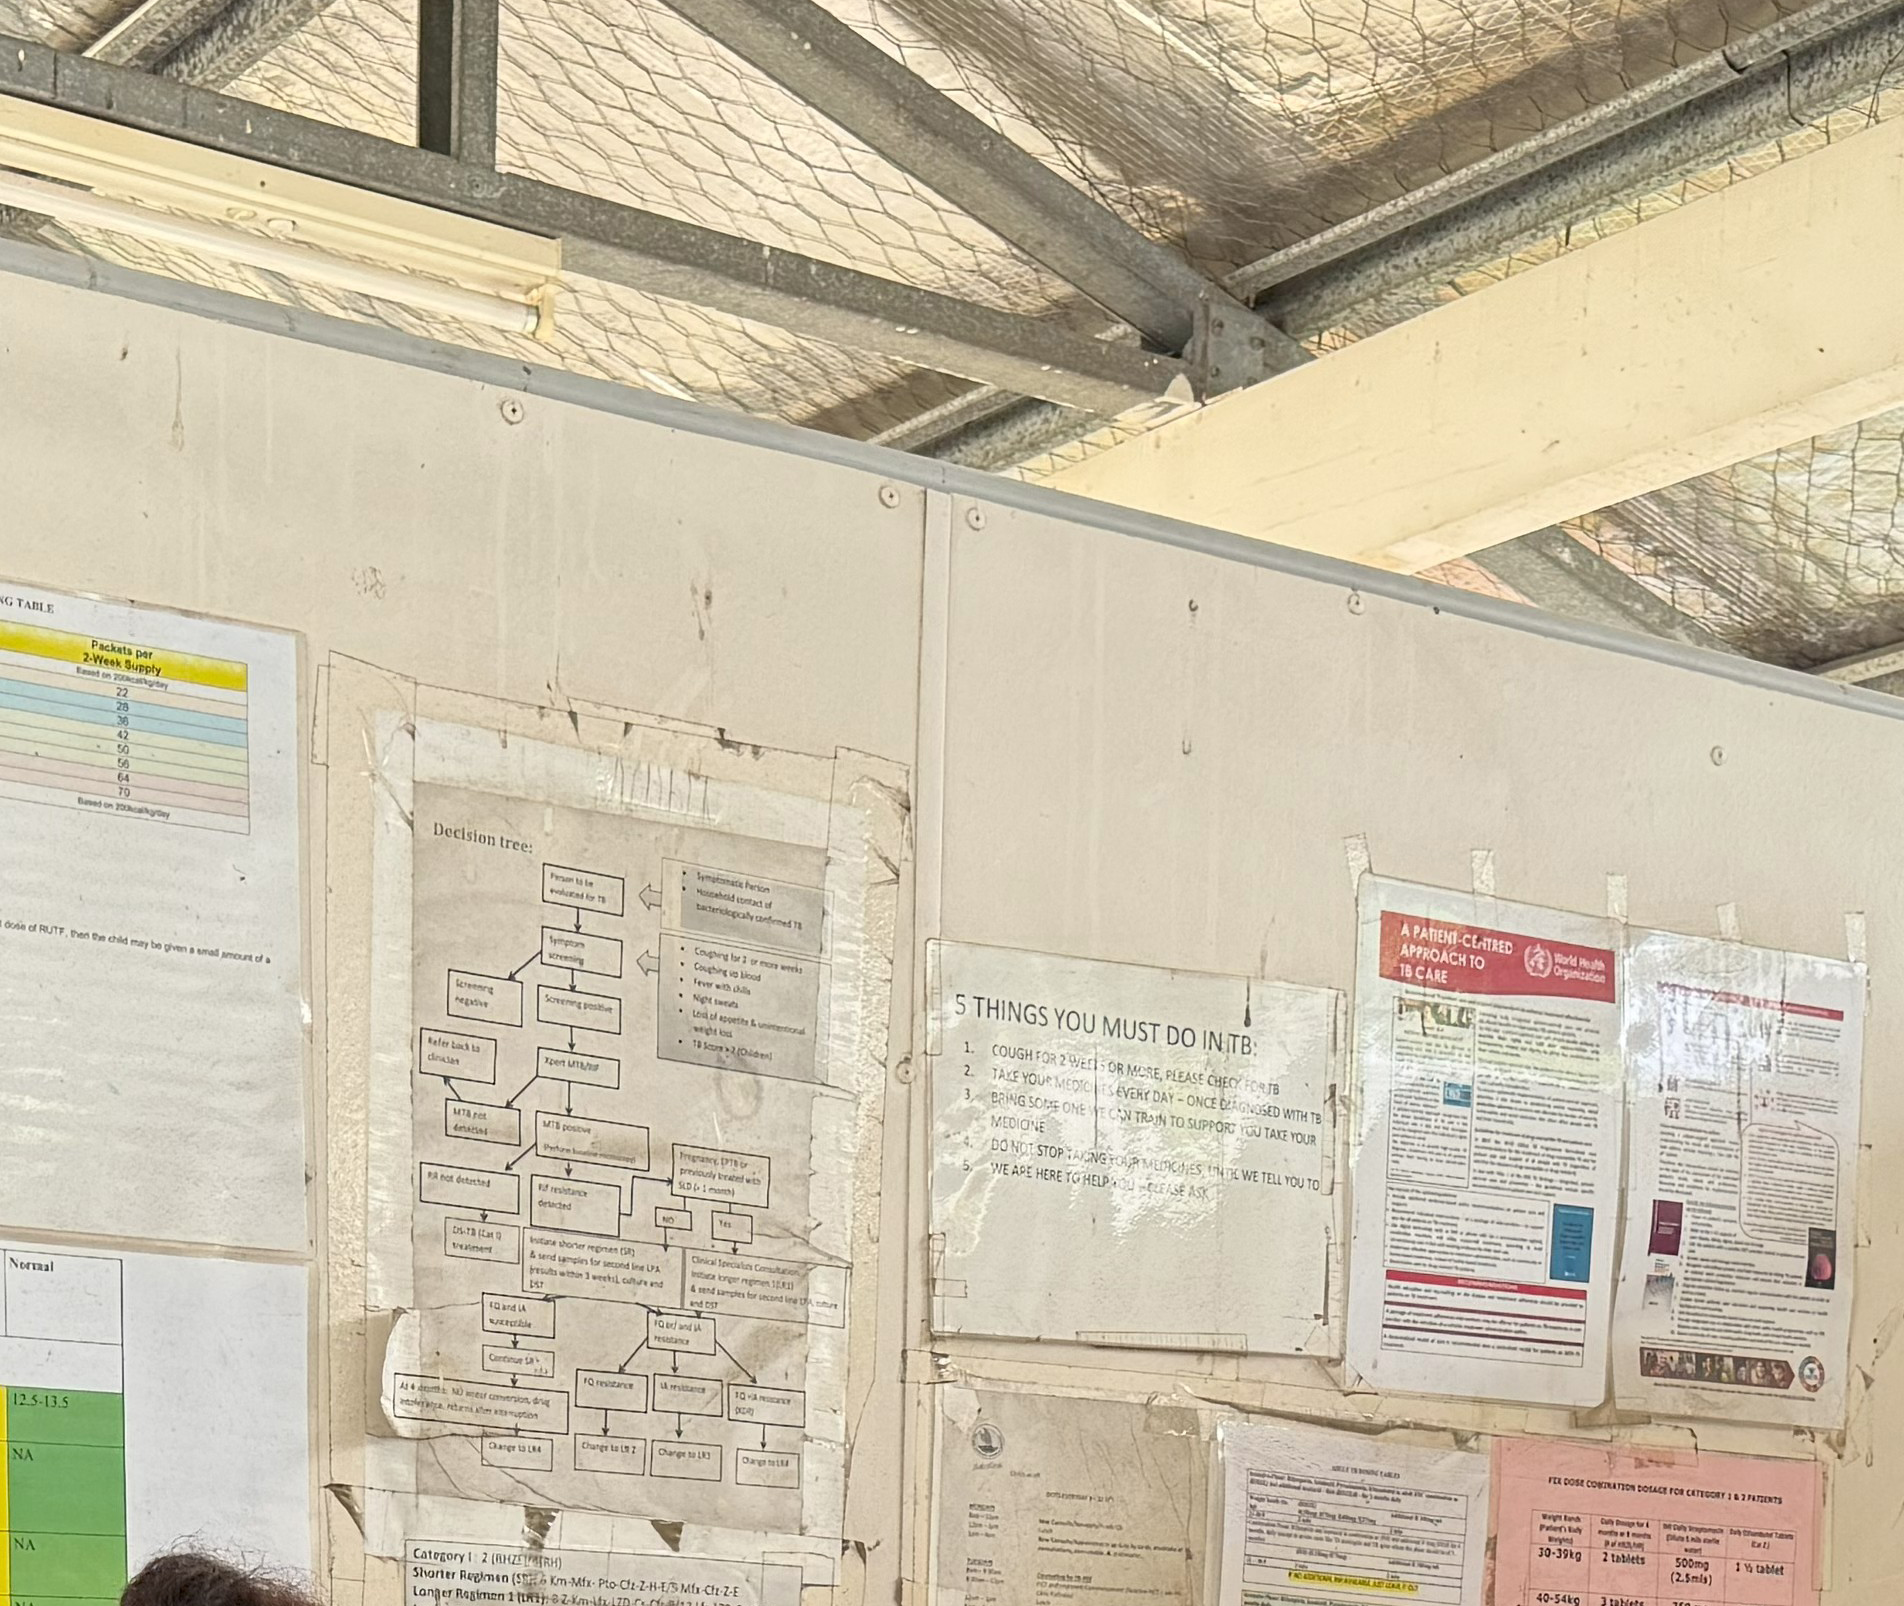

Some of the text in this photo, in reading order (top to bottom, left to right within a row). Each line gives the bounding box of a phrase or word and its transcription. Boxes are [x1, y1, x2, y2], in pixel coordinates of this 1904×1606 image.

[16, 598, 54, 615] TABLE
[91, 639, 153, 661] Packets per
[83, 651, 162, 676] 2-Week Supply
[433, 821, 533, 854] Decision tree:
[1400, 923, 1513, 956] A PATIENT-CENTRED
[1400, 945, 1485, 970] APPROACH TO
[1553, 952, 1606, 972] World Health
[1415, 967, 1448, 985] CARE
[1553, 964, 1607, 984] Organization
[954, 993, 1258, 1057] 5 THINGS YOU MUST DO IN TB:
[9, 1256, 54, 1272] Normal
[13, 1392, 69, 1409] 12.5-13.5
[12, 1447, 34, 1462] NA
[13, 1537, 36, 1551] NA
[413, 1547, 465, 1565] Category
[1538, 1548, 1582, 1563] 30-39kg
[1602, 1551, 1646, 1566] 2 tablets
[1675, 1558, 1710, 1572] 500mg
